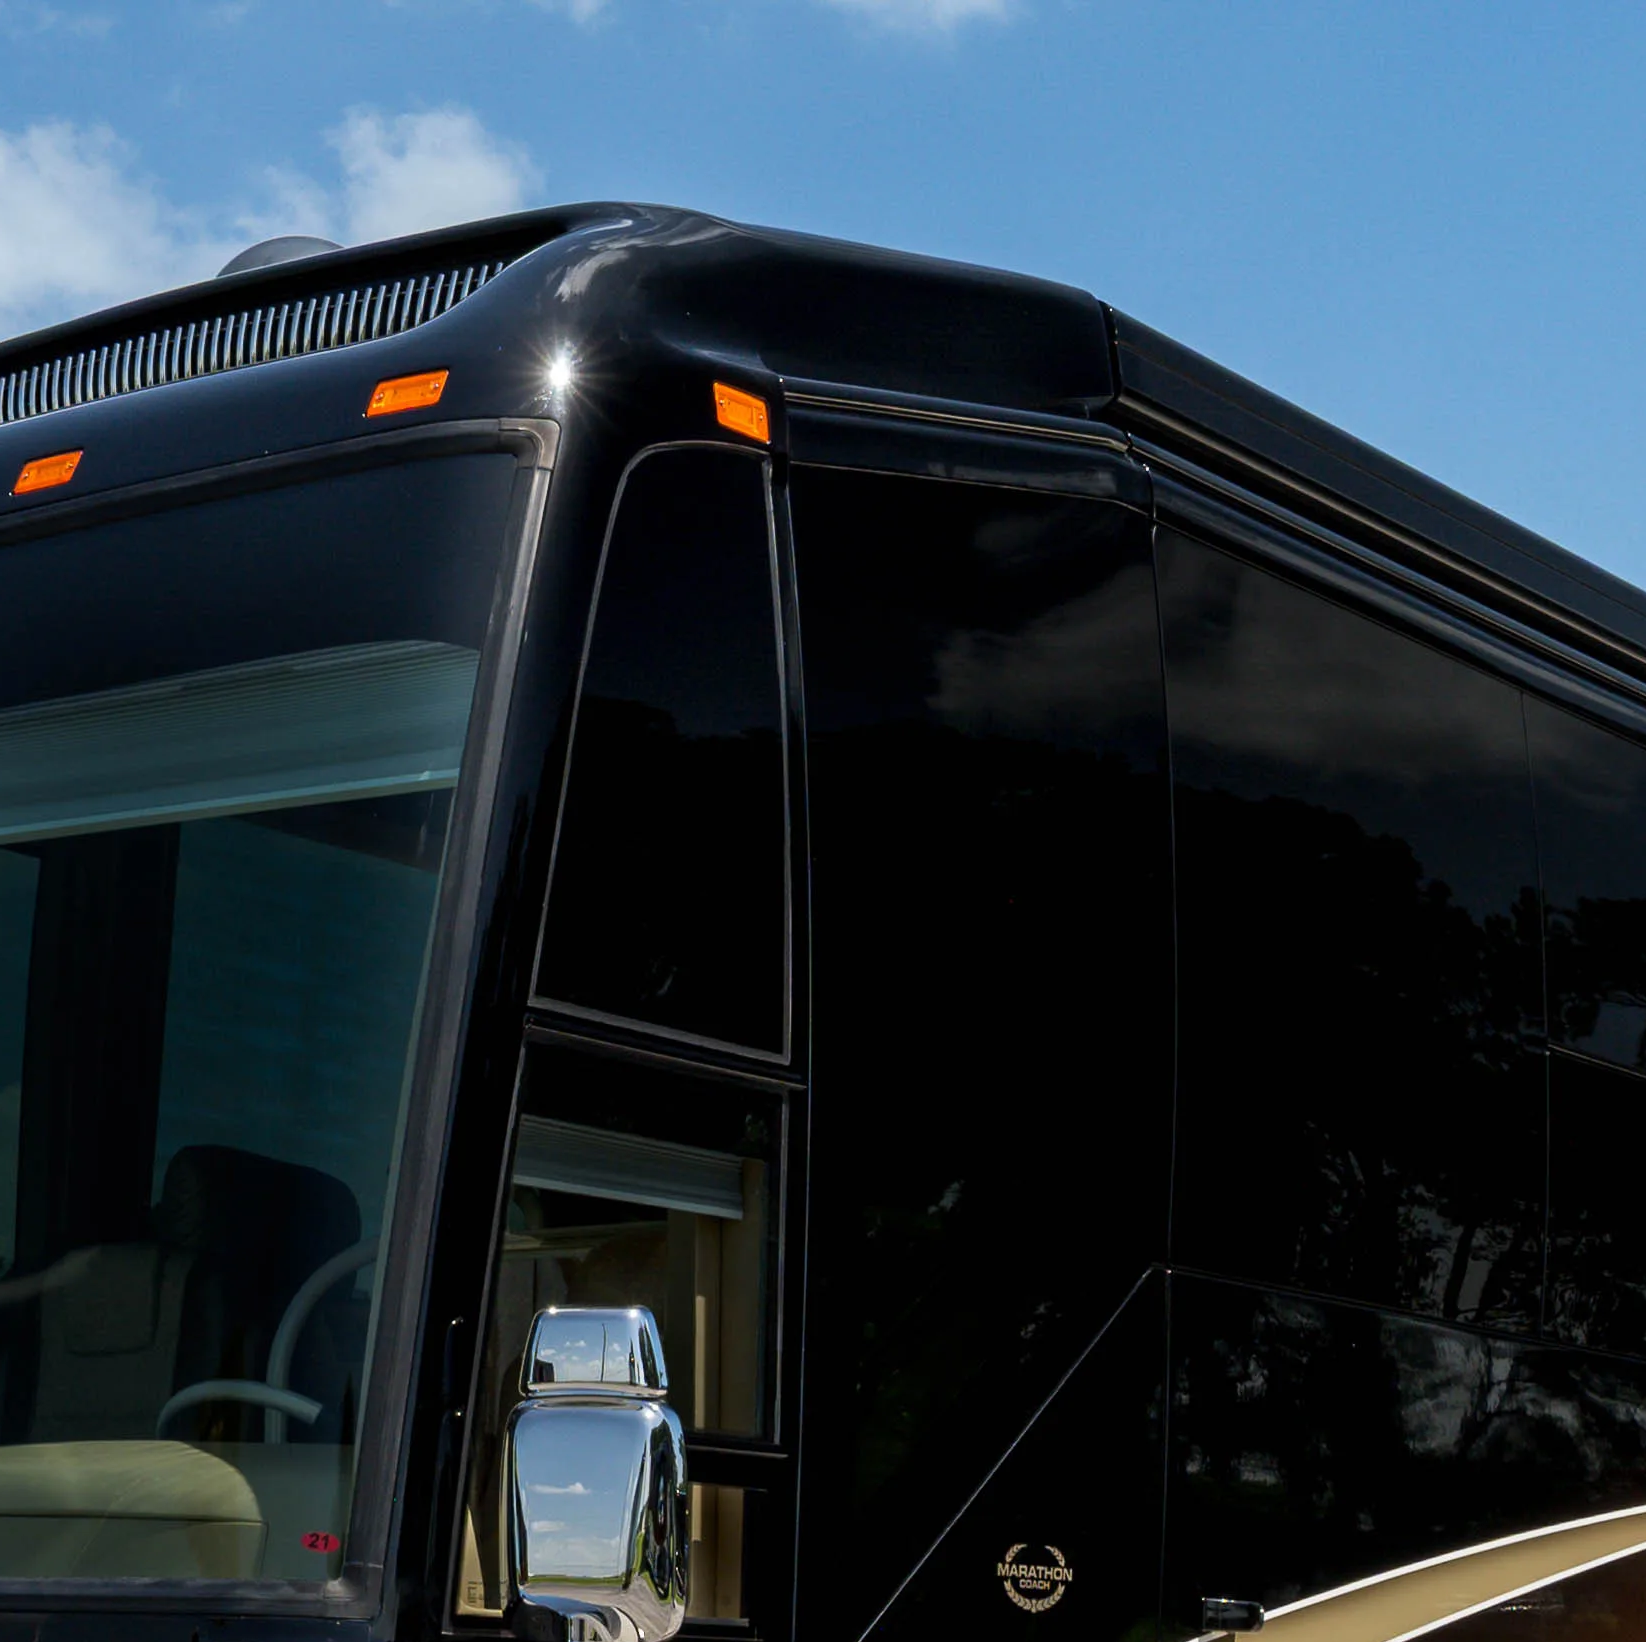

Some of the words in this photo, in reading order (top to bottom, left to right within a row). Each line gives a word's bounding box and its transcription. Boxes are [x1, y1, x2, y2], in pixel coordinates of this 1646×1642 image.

[307, 1532, 329, 1550] 21
[996, 1562, 1073, 1582] MARATHON
[1019, 1578, 1051, 1590] COACH
